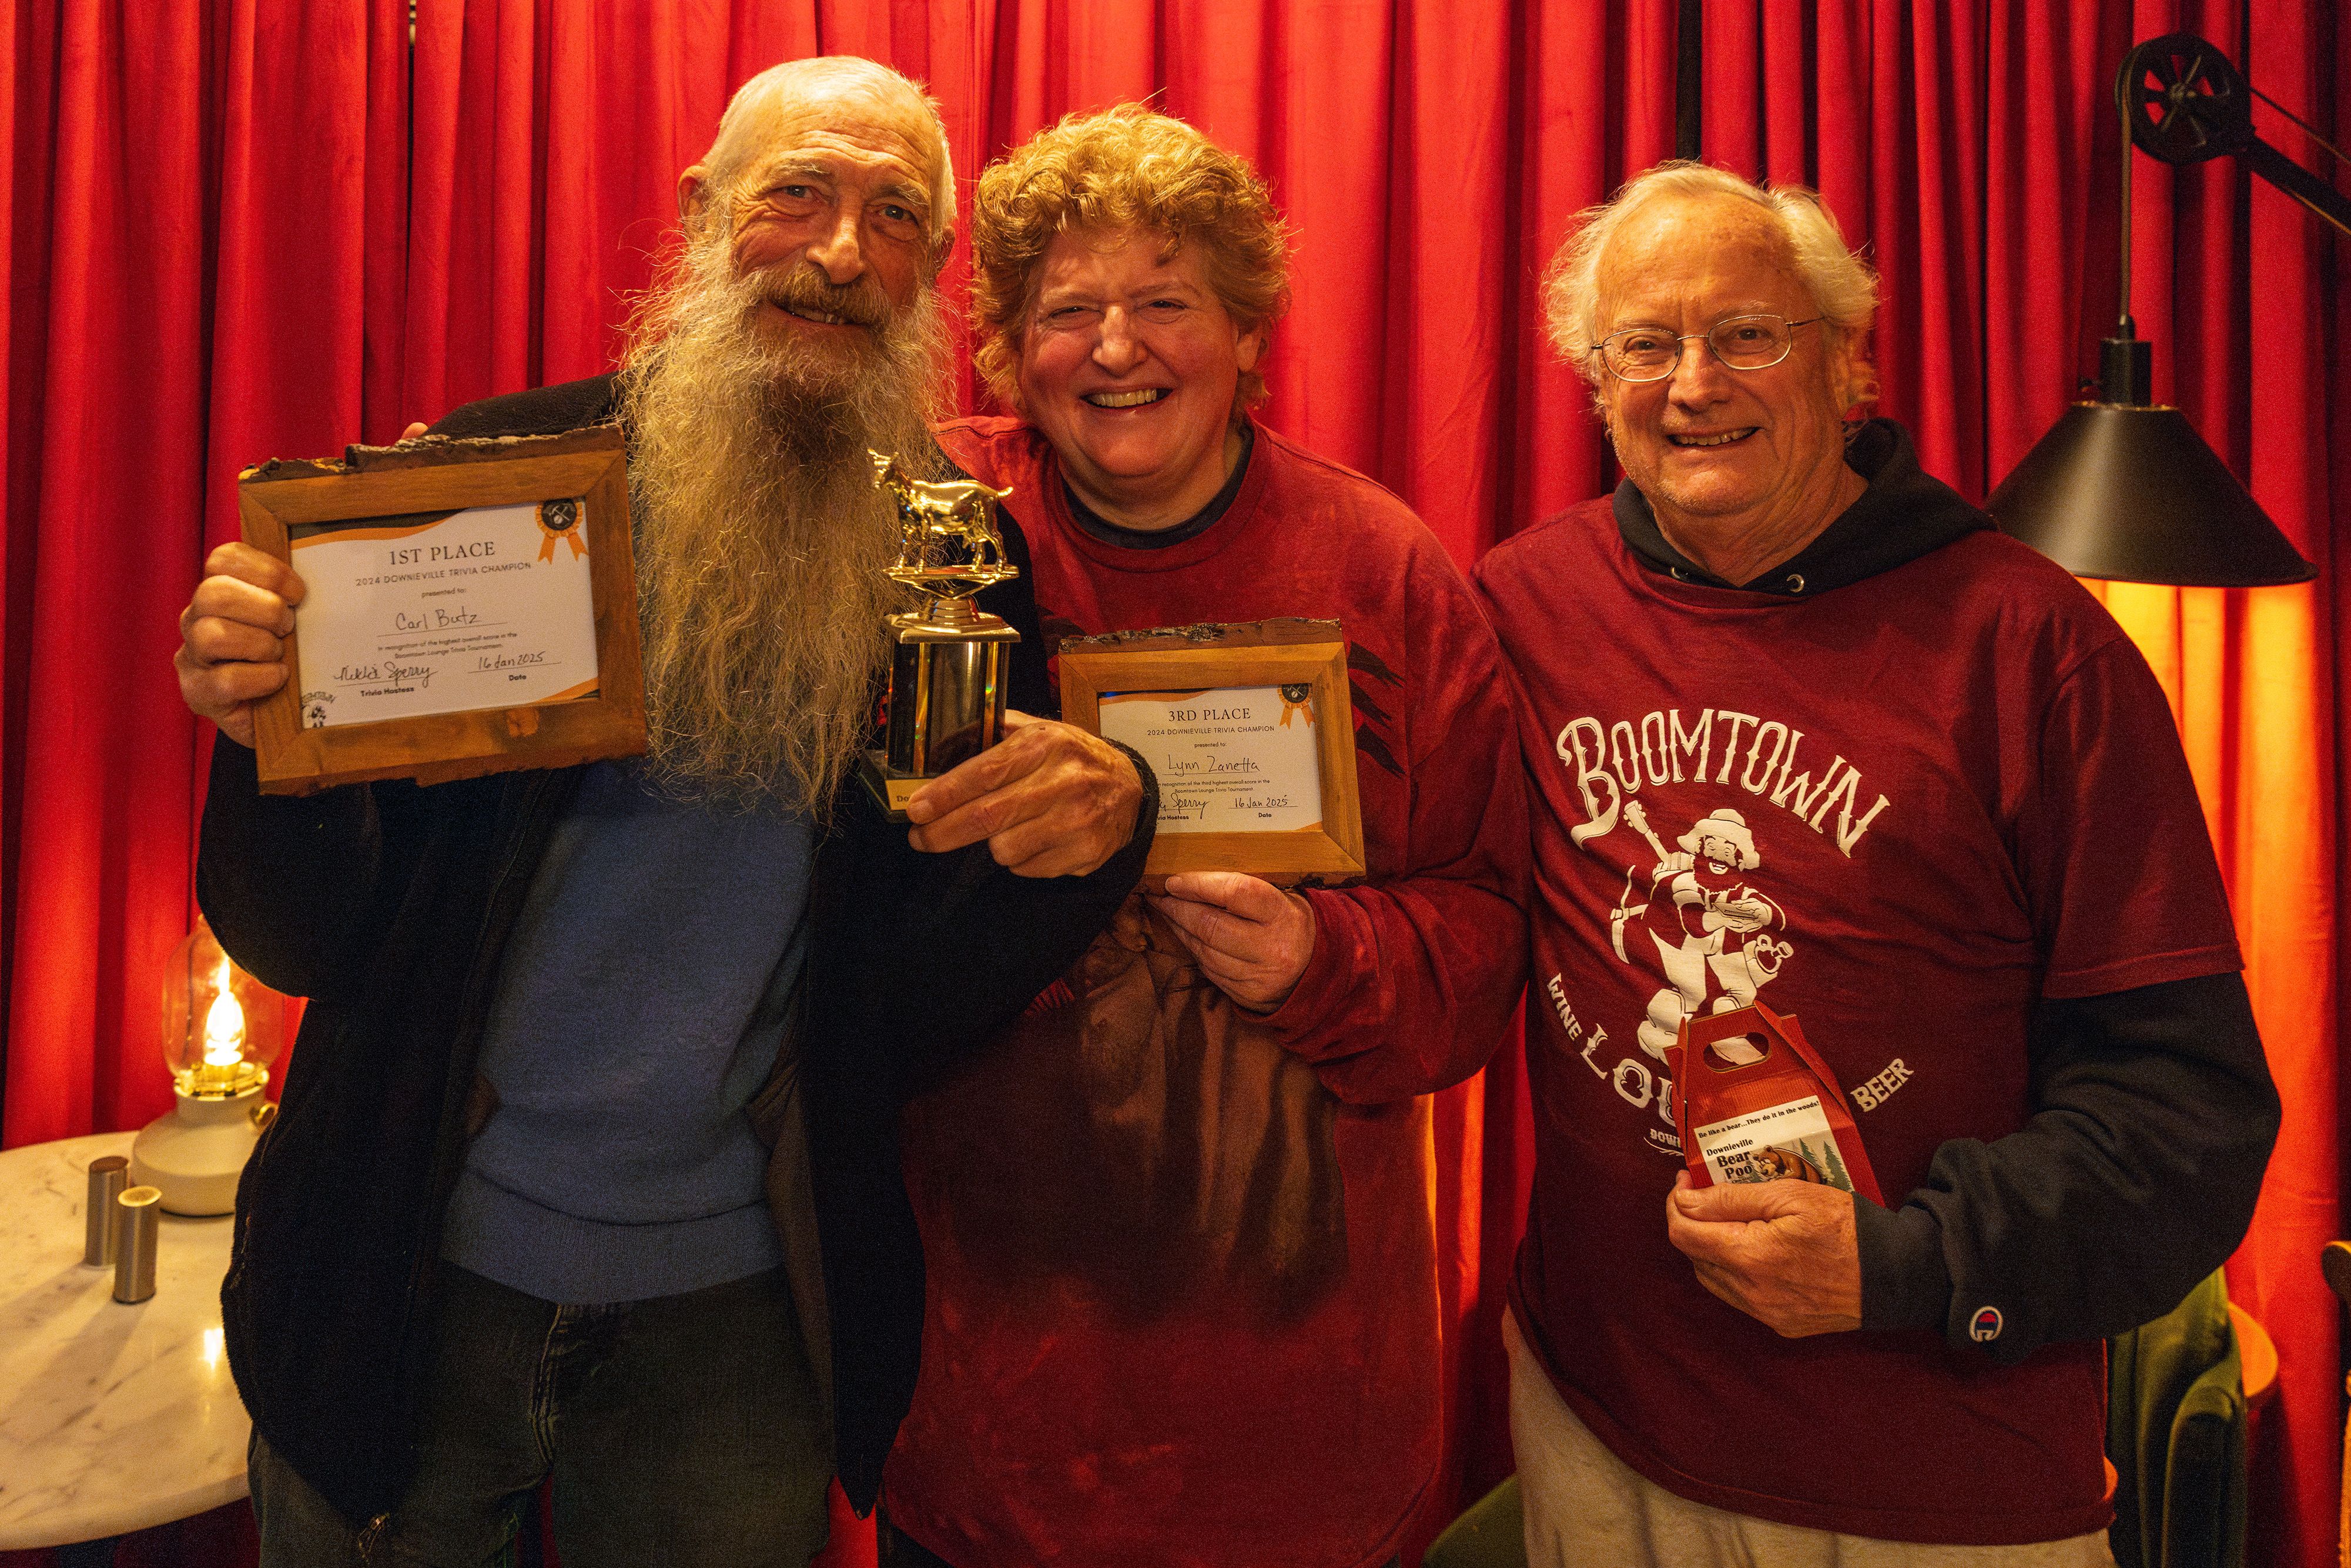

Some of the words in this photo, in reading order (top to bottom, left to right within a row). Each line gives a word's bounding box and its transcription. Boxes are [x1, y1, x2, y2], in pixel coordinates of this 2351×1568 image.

[390, 548, 421, 565] 1ST
[430, 541, 496, 561] PLACE
[356, 577, 380, 587] 2024
[384, 570, 445, 583] DOWNIEVILLE
[449, 567, 478, 577] TRIVIA
[481, 562, 531, 574] CHAMPION
[395, 612, 428, 631] Carl
[435, 606, 482, 627] Butz
[478, 656, 491, 670] 16
[517, 651, 545, 665] 2025
[384, 686, 414, 695] Hostess
[1168, 710, 1197, 722] 3RD
[1203, 708, 1251, 721] PLACE
[1168, 754, 1200, 777] Lynn
[1207, 755, 1260, 772] Zanetta
[1556, 708, 1891, 858] BOOMTOWN
[1170, 792, 1211, 819] Sperry
[1235, 797, 1244, 808] 16
[1247, 796, 1262, 808] Jan
[1266, 794, 1289, 807] 2025
[1547, 973, 1582, 1042] WINE
[1850, 1058, 1914, 1113] BEER
[1797, 1100, 1820, 1111] woods!
[1706, 1138, 1753, 1157] Downieville
[1716, 1151, 1750, 1167] Bear
[1724, 1164, 1753, 1180] Poo
